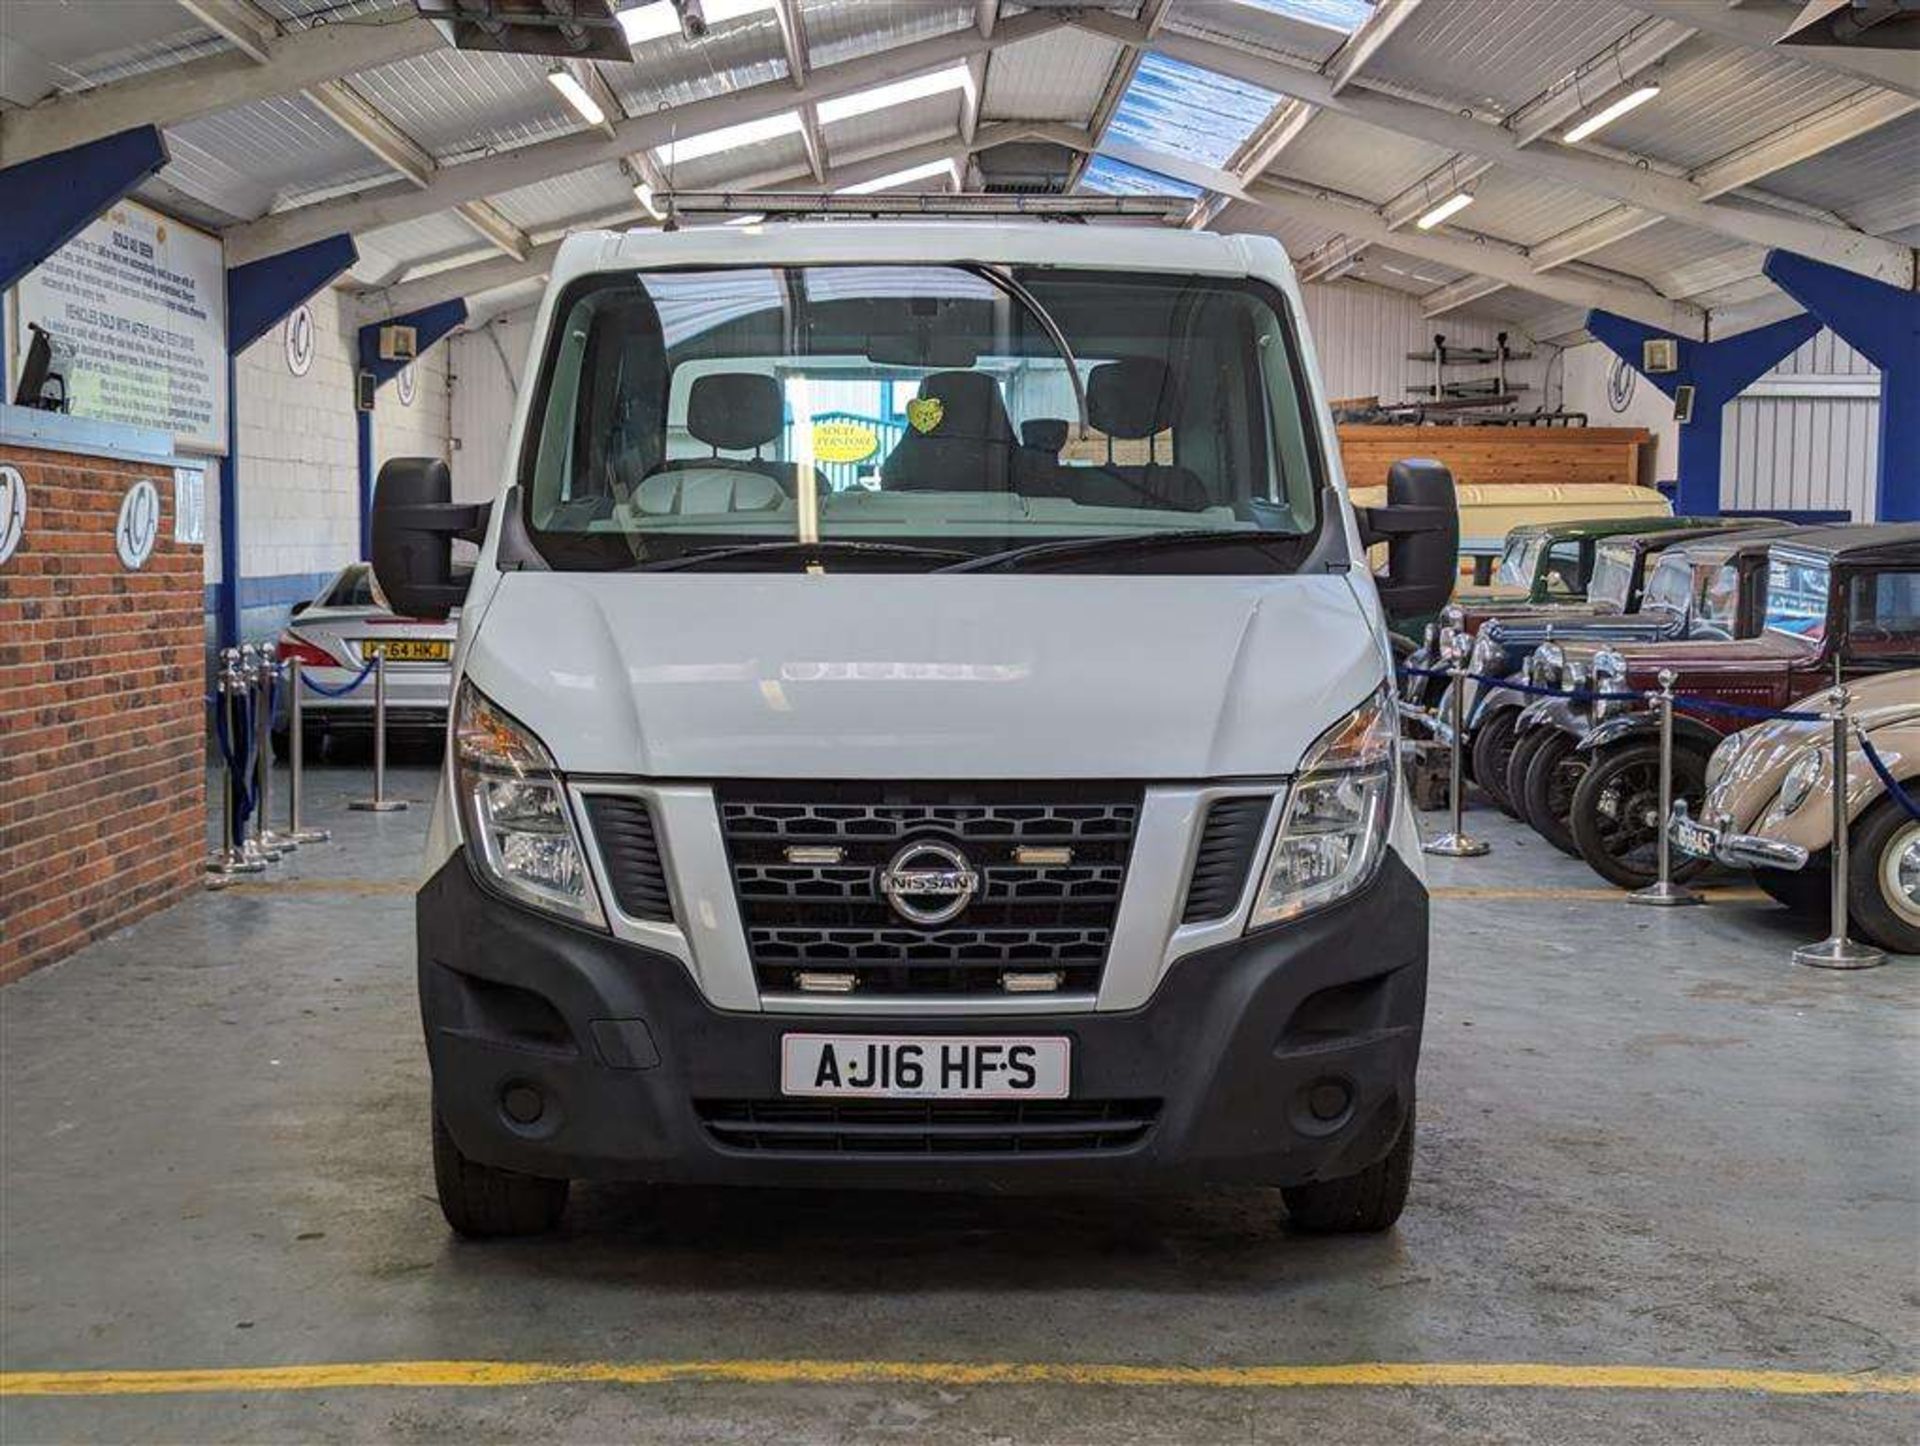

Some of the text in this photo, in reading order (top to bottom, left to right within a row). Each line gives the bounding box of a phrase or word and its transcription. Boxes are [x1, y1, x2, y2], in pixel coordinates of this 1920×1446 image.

[890, 876, 970, 891] NISSAN
[814, 1043, 1037, 1090] AJ16 HFS
